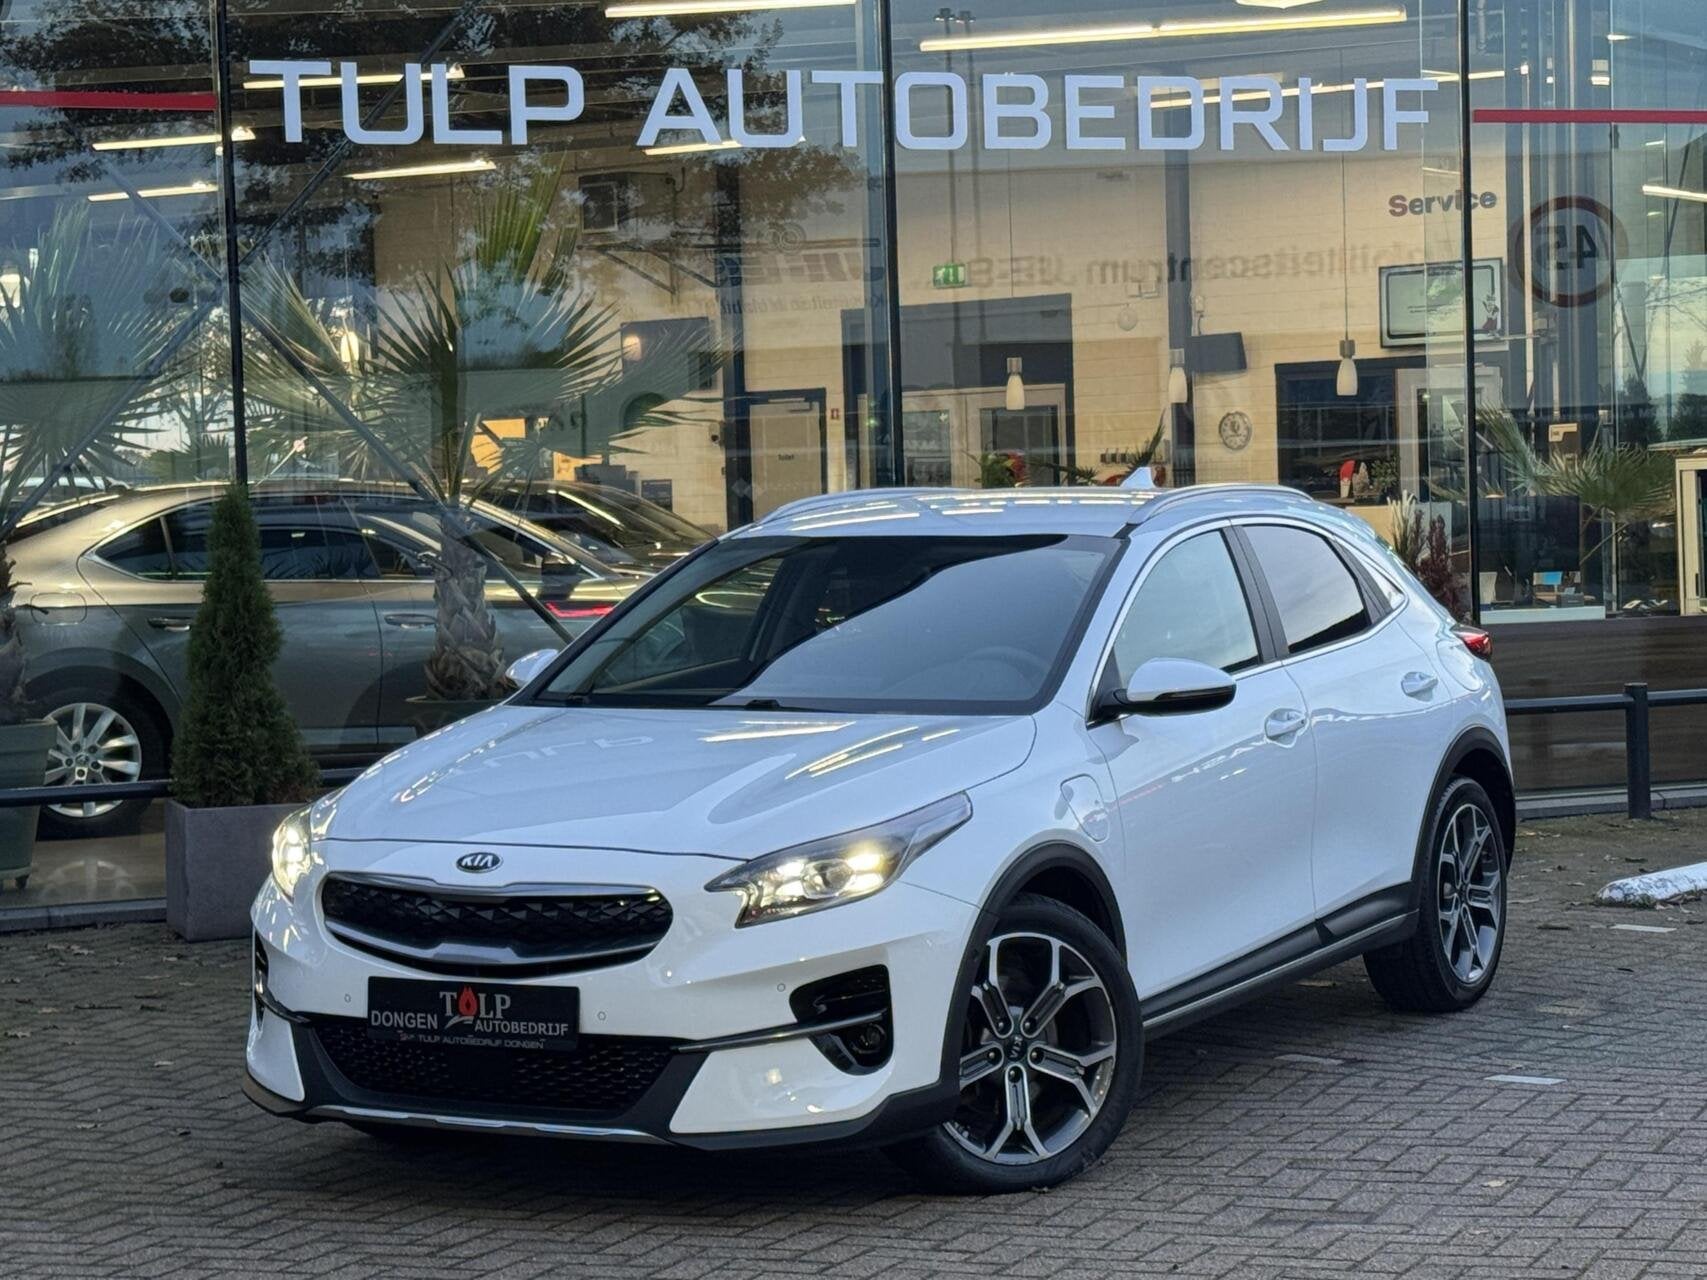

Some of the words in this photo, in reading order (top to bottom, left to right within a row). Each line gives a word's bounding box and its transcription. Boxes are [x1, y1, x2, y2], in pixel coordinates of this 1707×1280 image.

[249, 60, 585, 145] TULP
[635, 66, 1439, 152] AUTOBEDRIJF
[1388, 189, 1497, 217] Service
[461, 853, 495, 868] KIA
[371, 1010, 438, 1030] DONGEN
[474, 1019, 569, 1037] AUTOBEDRIJF
[418, 1033, 440, 1044] TULP
[504, 1039, 545, 1050] DONGEN
